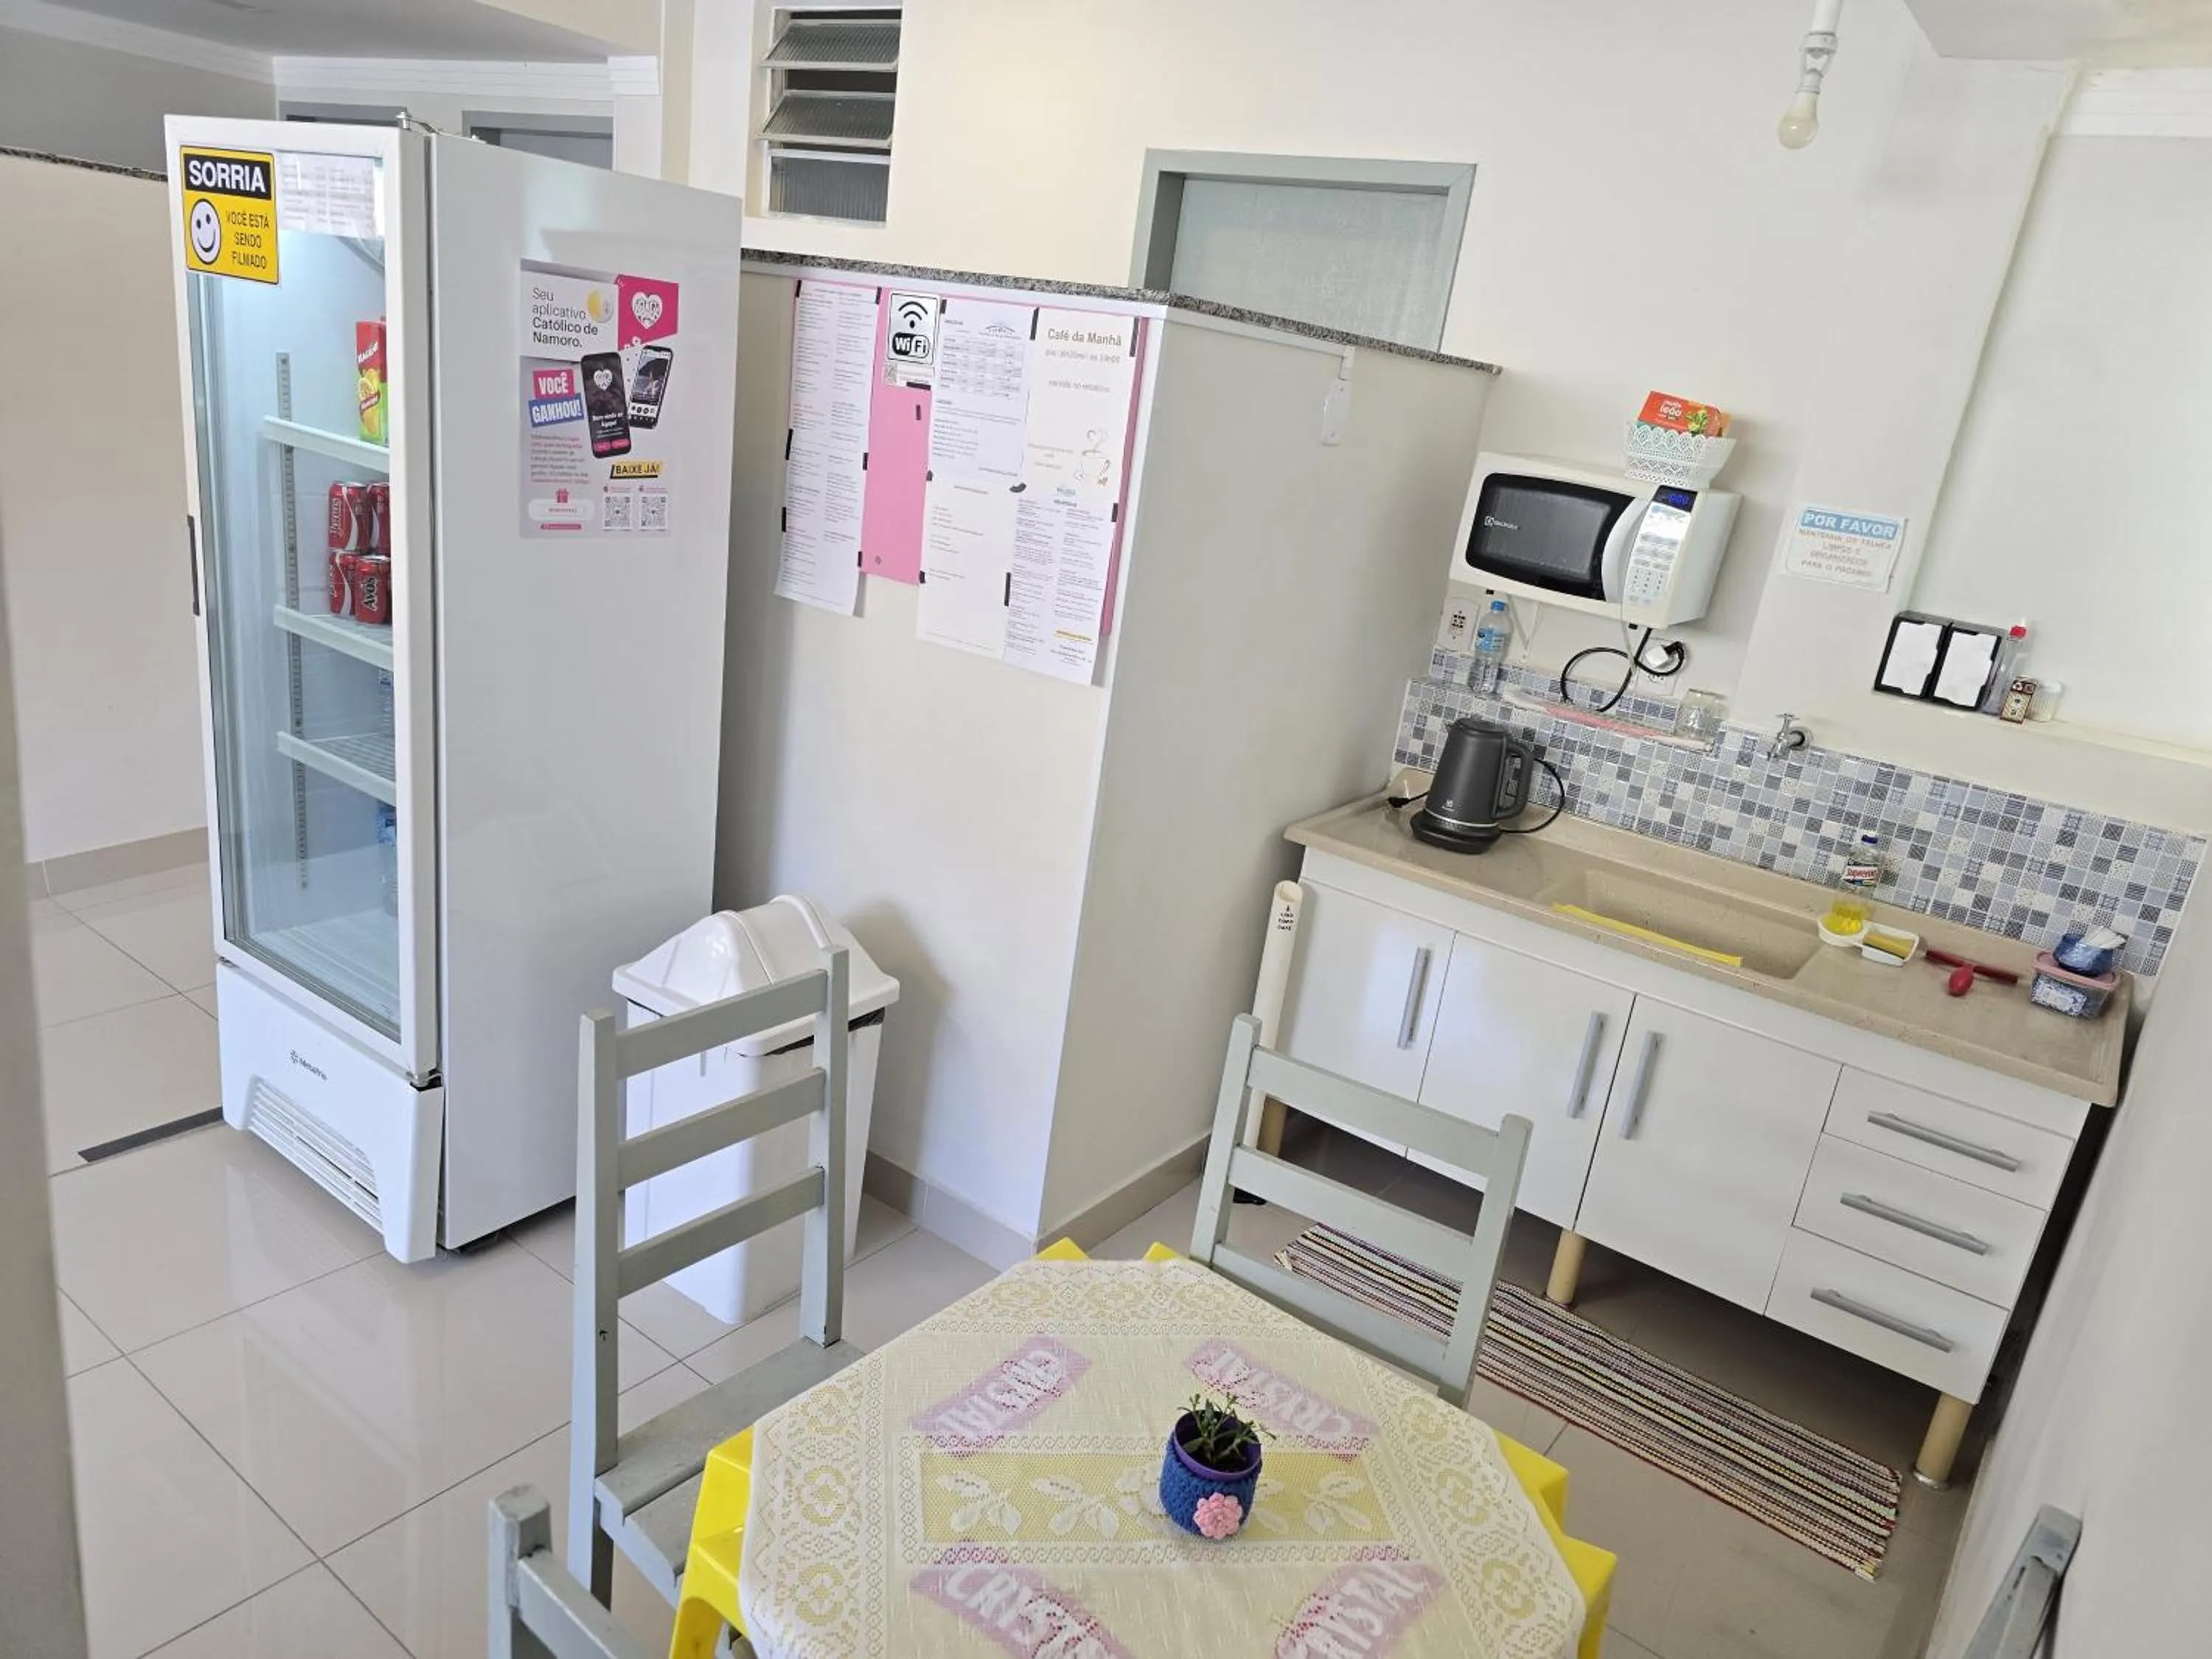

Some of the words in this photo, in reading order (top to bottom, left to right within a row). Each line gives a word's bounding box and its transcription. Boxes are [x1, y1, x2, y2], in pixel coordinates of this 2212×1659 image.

[188, 159, 266, 193] SORRIA
[226, 209, 247, 226] VOCÊ
[248, 212, 270, 229] ESTÁ
[234, 232, 262, 248] SENDO
[232, 251, 267, 270] FILMADO
[532, 288, 554, 302] Seu
[532, 303, 587, 320] aplicativo
[532, 316, 581, 334] Católico
[583, 323, 599, 335] de
[532, 332, 583, 348] Namoro.
[1048, 328, 1070, 341] Café
[1071, 330, 1085, 343] da
[538, 372, 569, 396] VOCÊ
[532, 400, 582, 424] GANHOU!
[616, 464, 642, 475] BAIXE
[1804, 512, 1837, 529] POR
[1840, 518, 1896, 538] FAVOR
